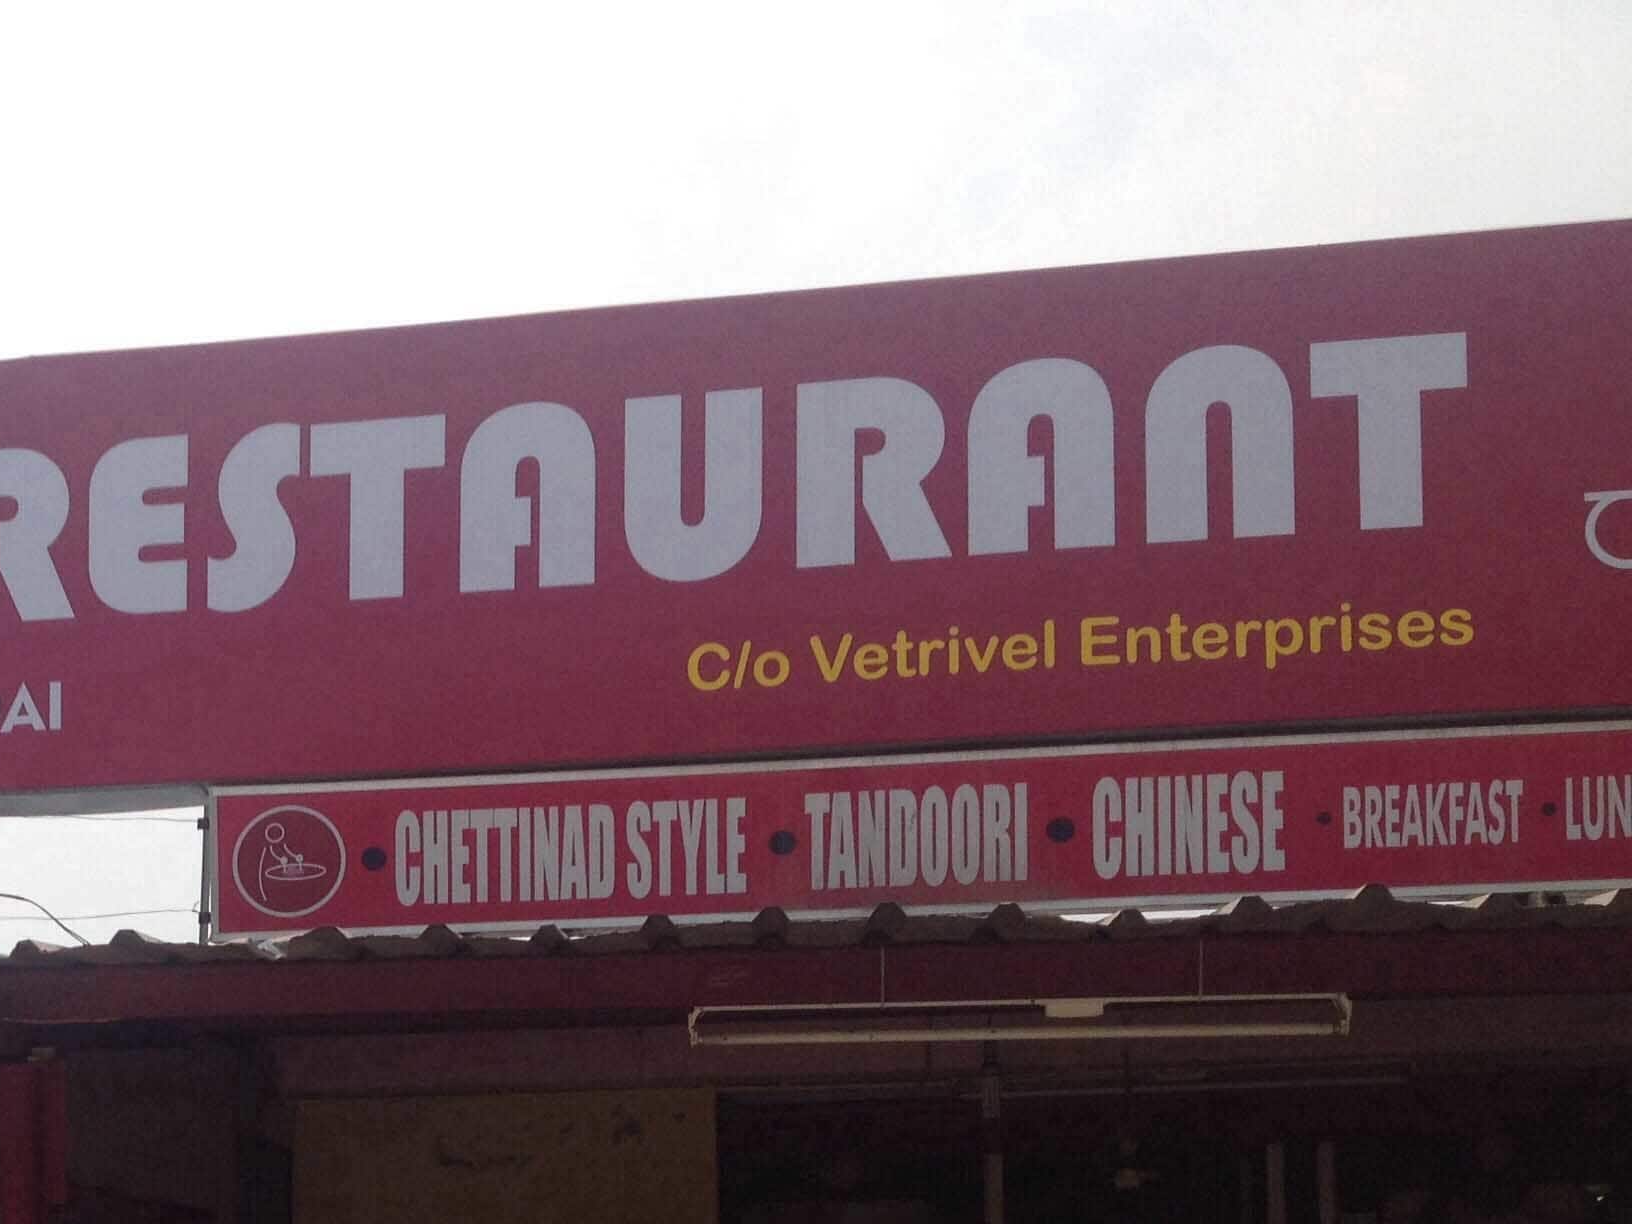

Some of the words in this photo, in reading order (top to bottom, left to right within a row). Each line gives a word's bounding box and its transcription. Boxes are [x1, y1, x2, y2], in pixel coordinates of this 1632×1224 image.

[688, 640, 789, 690] C/o
[810, 620, 1055, 682] Vetrivel
[1081, 603, 1473, 669] Enterprises
[396, 805, 615, 906] CHETTINAD
[627, 797, 748, 902] STYLE
[805, 784, 1027, 889] TANDOORI
[1093, 771, 1285, 879] CHINESE
[1344, 780, 1523, 848] BREAKFAST
